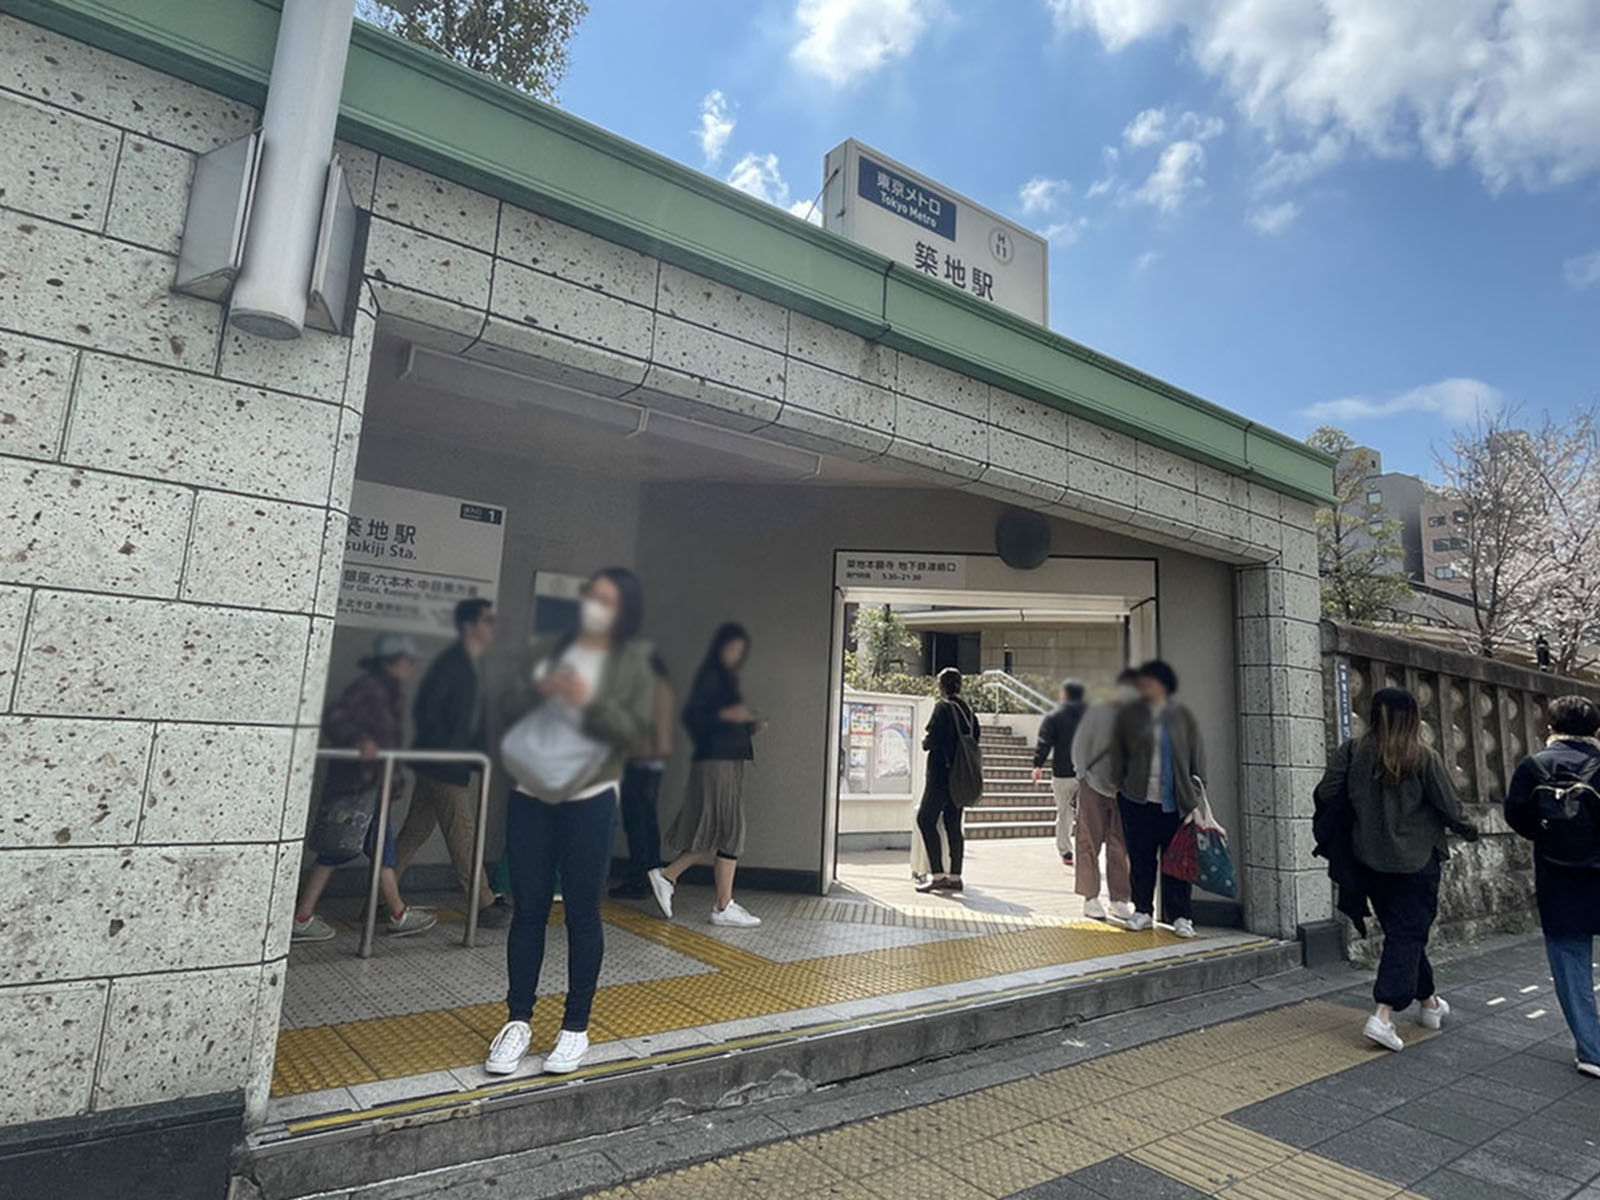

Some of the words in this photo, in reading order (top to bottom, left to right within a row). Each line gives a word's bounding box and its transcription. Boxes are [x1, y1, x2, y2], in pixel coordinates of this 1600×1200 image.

[876, 171, 941, 216] 東京メトロ
[880, 191, 908, 214] Tokyo
[909, 205, 937, 228] Metro
[997, 233, 1006, 245] H
[995, 244, 1007, 258] 11
[914, 241, 994, 301] 築地駅
[488, 510, 495, 523] 1
[390, 544, 417, 560] Sta.
